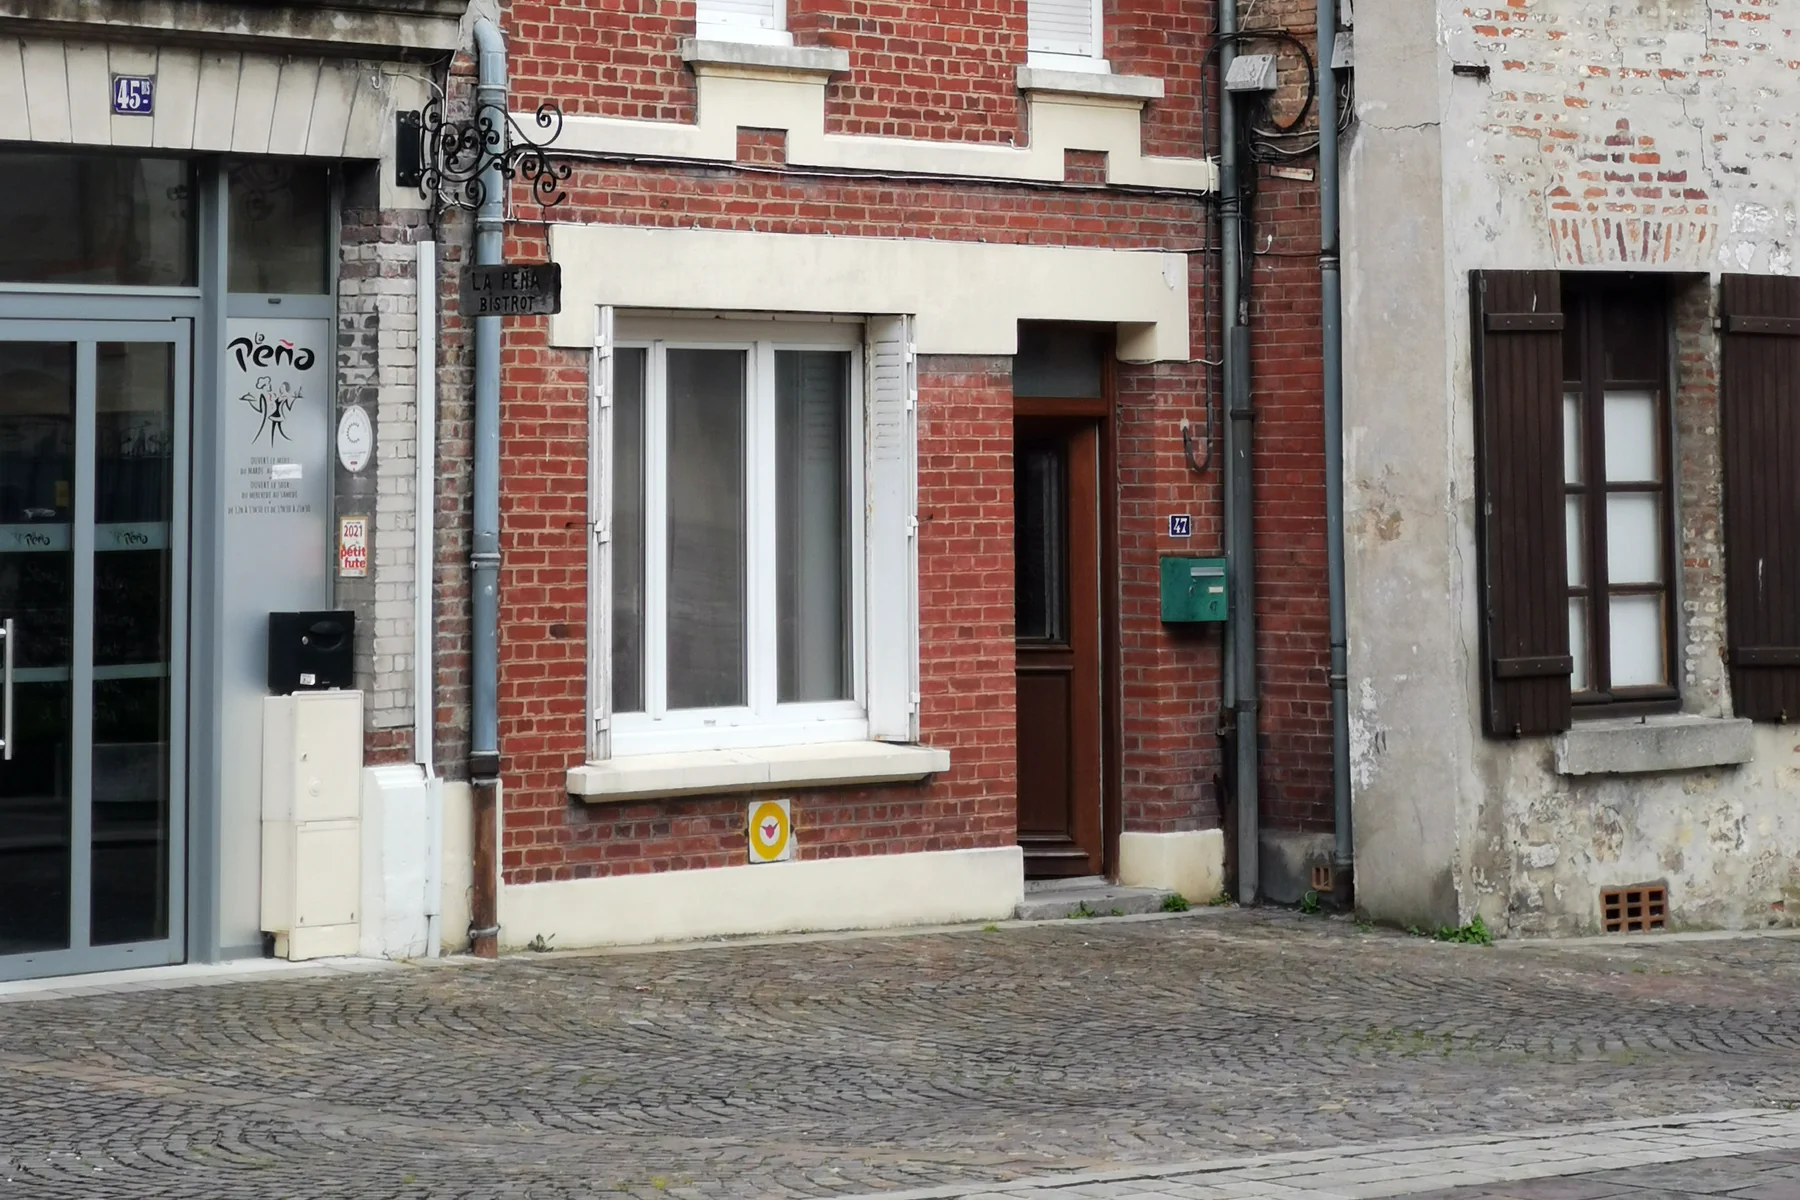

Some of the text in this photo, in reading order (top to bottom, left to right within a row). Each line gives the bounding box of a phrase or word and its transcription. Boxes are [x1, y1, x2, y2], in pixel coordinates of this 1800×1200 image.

[117, 79, 141, 109] 45
[472, 271, 492, 291] LA
[480, 295, 535, 312] BISTROT
[226, 337, 315, 373] Peña
[344, 525, 363, 537] 2021
[1174, 517, 1188, 534] 47
[340, 545, 366, 559] petit
